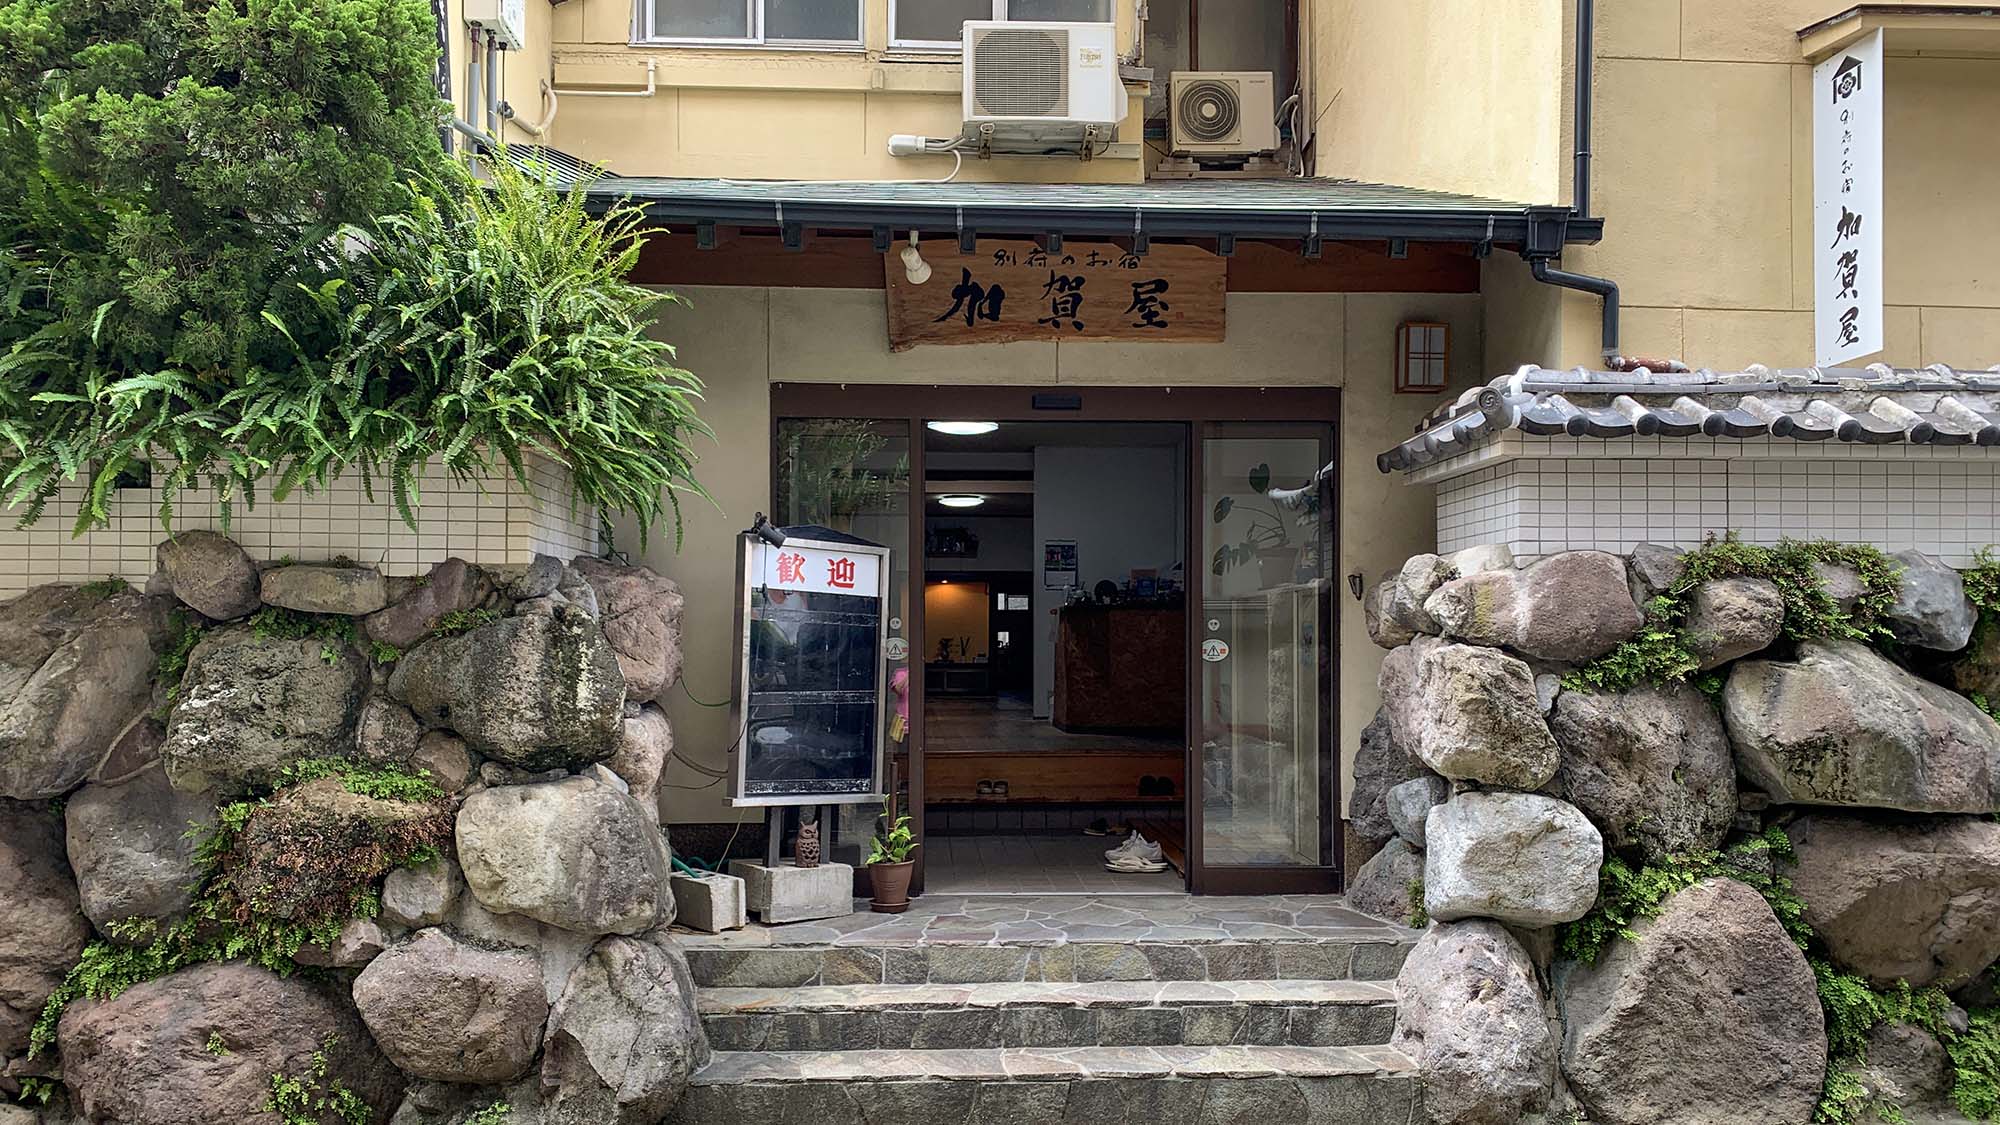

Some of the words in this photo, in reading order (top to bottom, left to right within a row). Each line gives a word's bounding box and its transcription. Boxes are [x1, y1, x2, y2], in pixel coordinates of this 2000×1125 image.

[933, 268, 1169, 331] 加賀屋
[1831, 206, 1862, 348] 加賀屋
[776, 553, 855, 588] 歓迎
